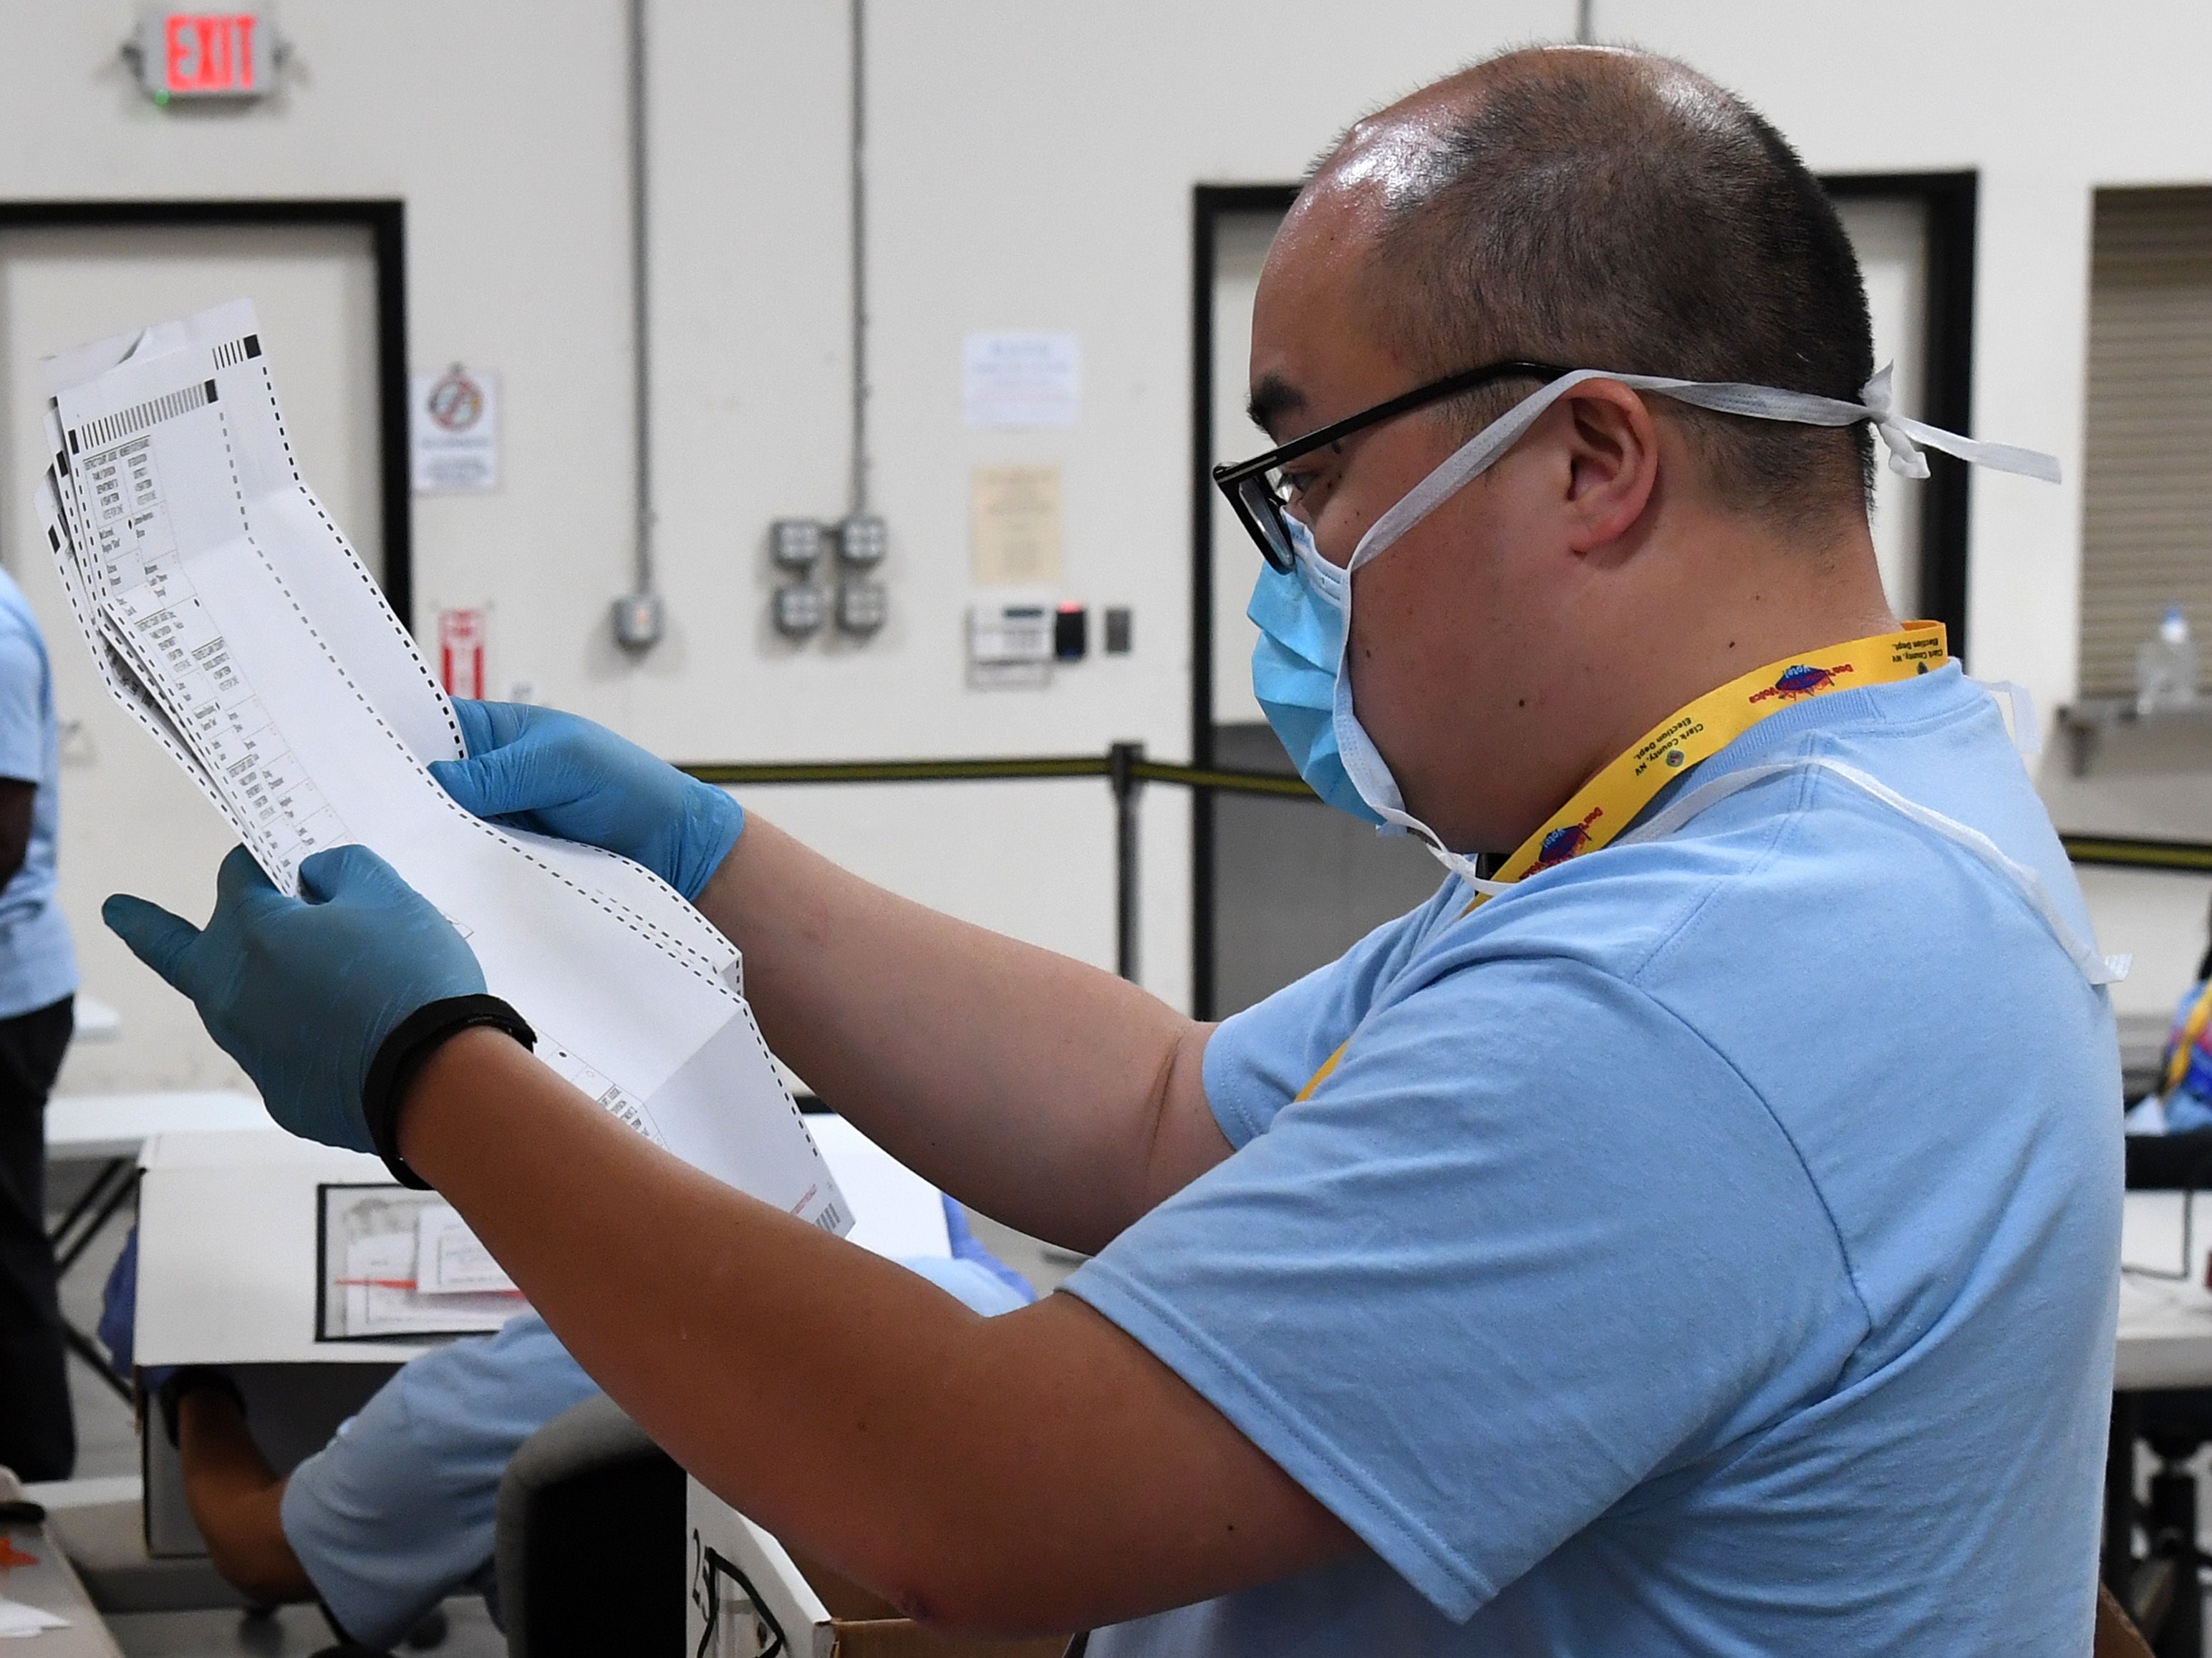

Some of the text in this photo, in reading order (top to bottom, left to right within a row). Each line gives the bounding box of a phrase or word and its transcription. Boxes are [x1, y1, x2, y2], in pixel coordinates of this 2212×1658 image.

[165, 14, 256, 91] EXIT
[1912, 637, 1938, 648] Election
[1928, 648, 1943, 658] Clark
[1633, 717, 1691, 760] Election Dept.
[1635, 723, 1704, 776] Clark County, NV
